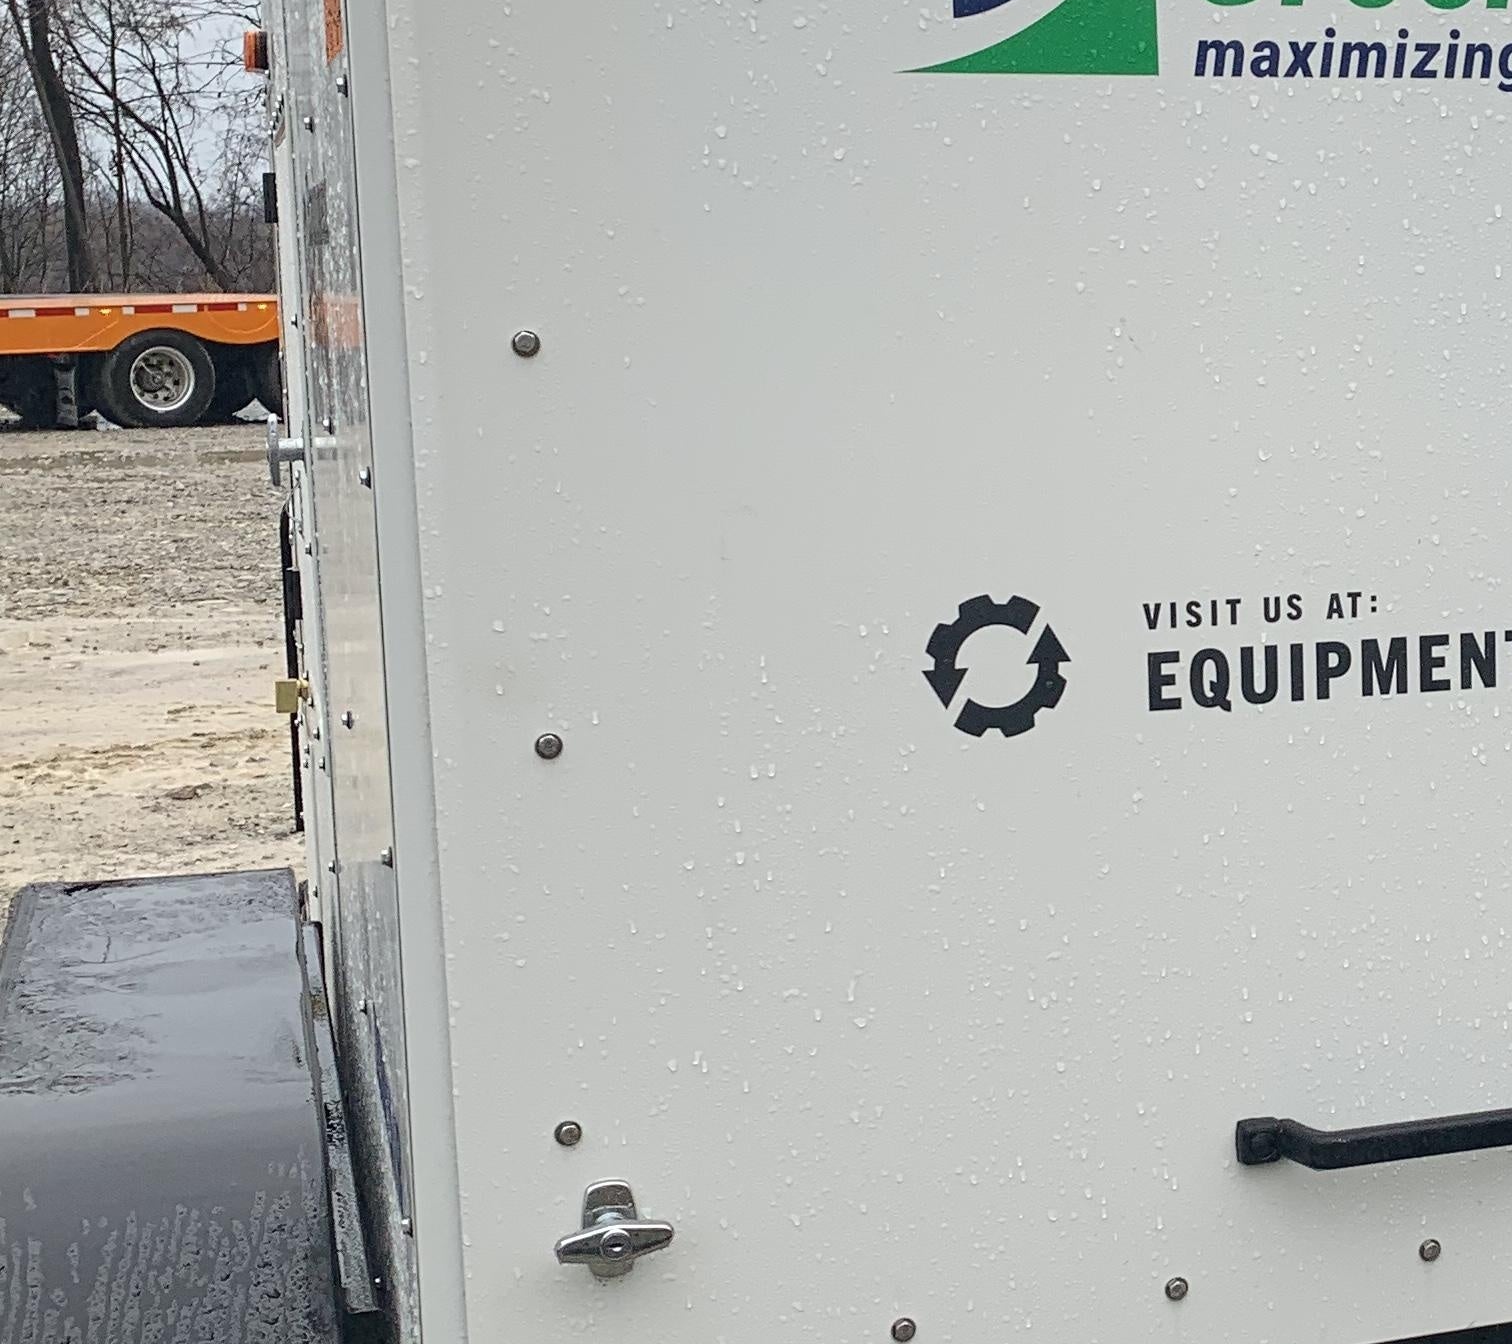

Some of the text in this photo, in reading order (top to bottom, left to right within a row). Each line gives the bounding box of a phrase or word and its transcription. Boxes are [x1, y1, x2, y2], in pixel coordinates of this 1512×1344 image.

[1142, 590, 1379, 630] VISIT US AT:
